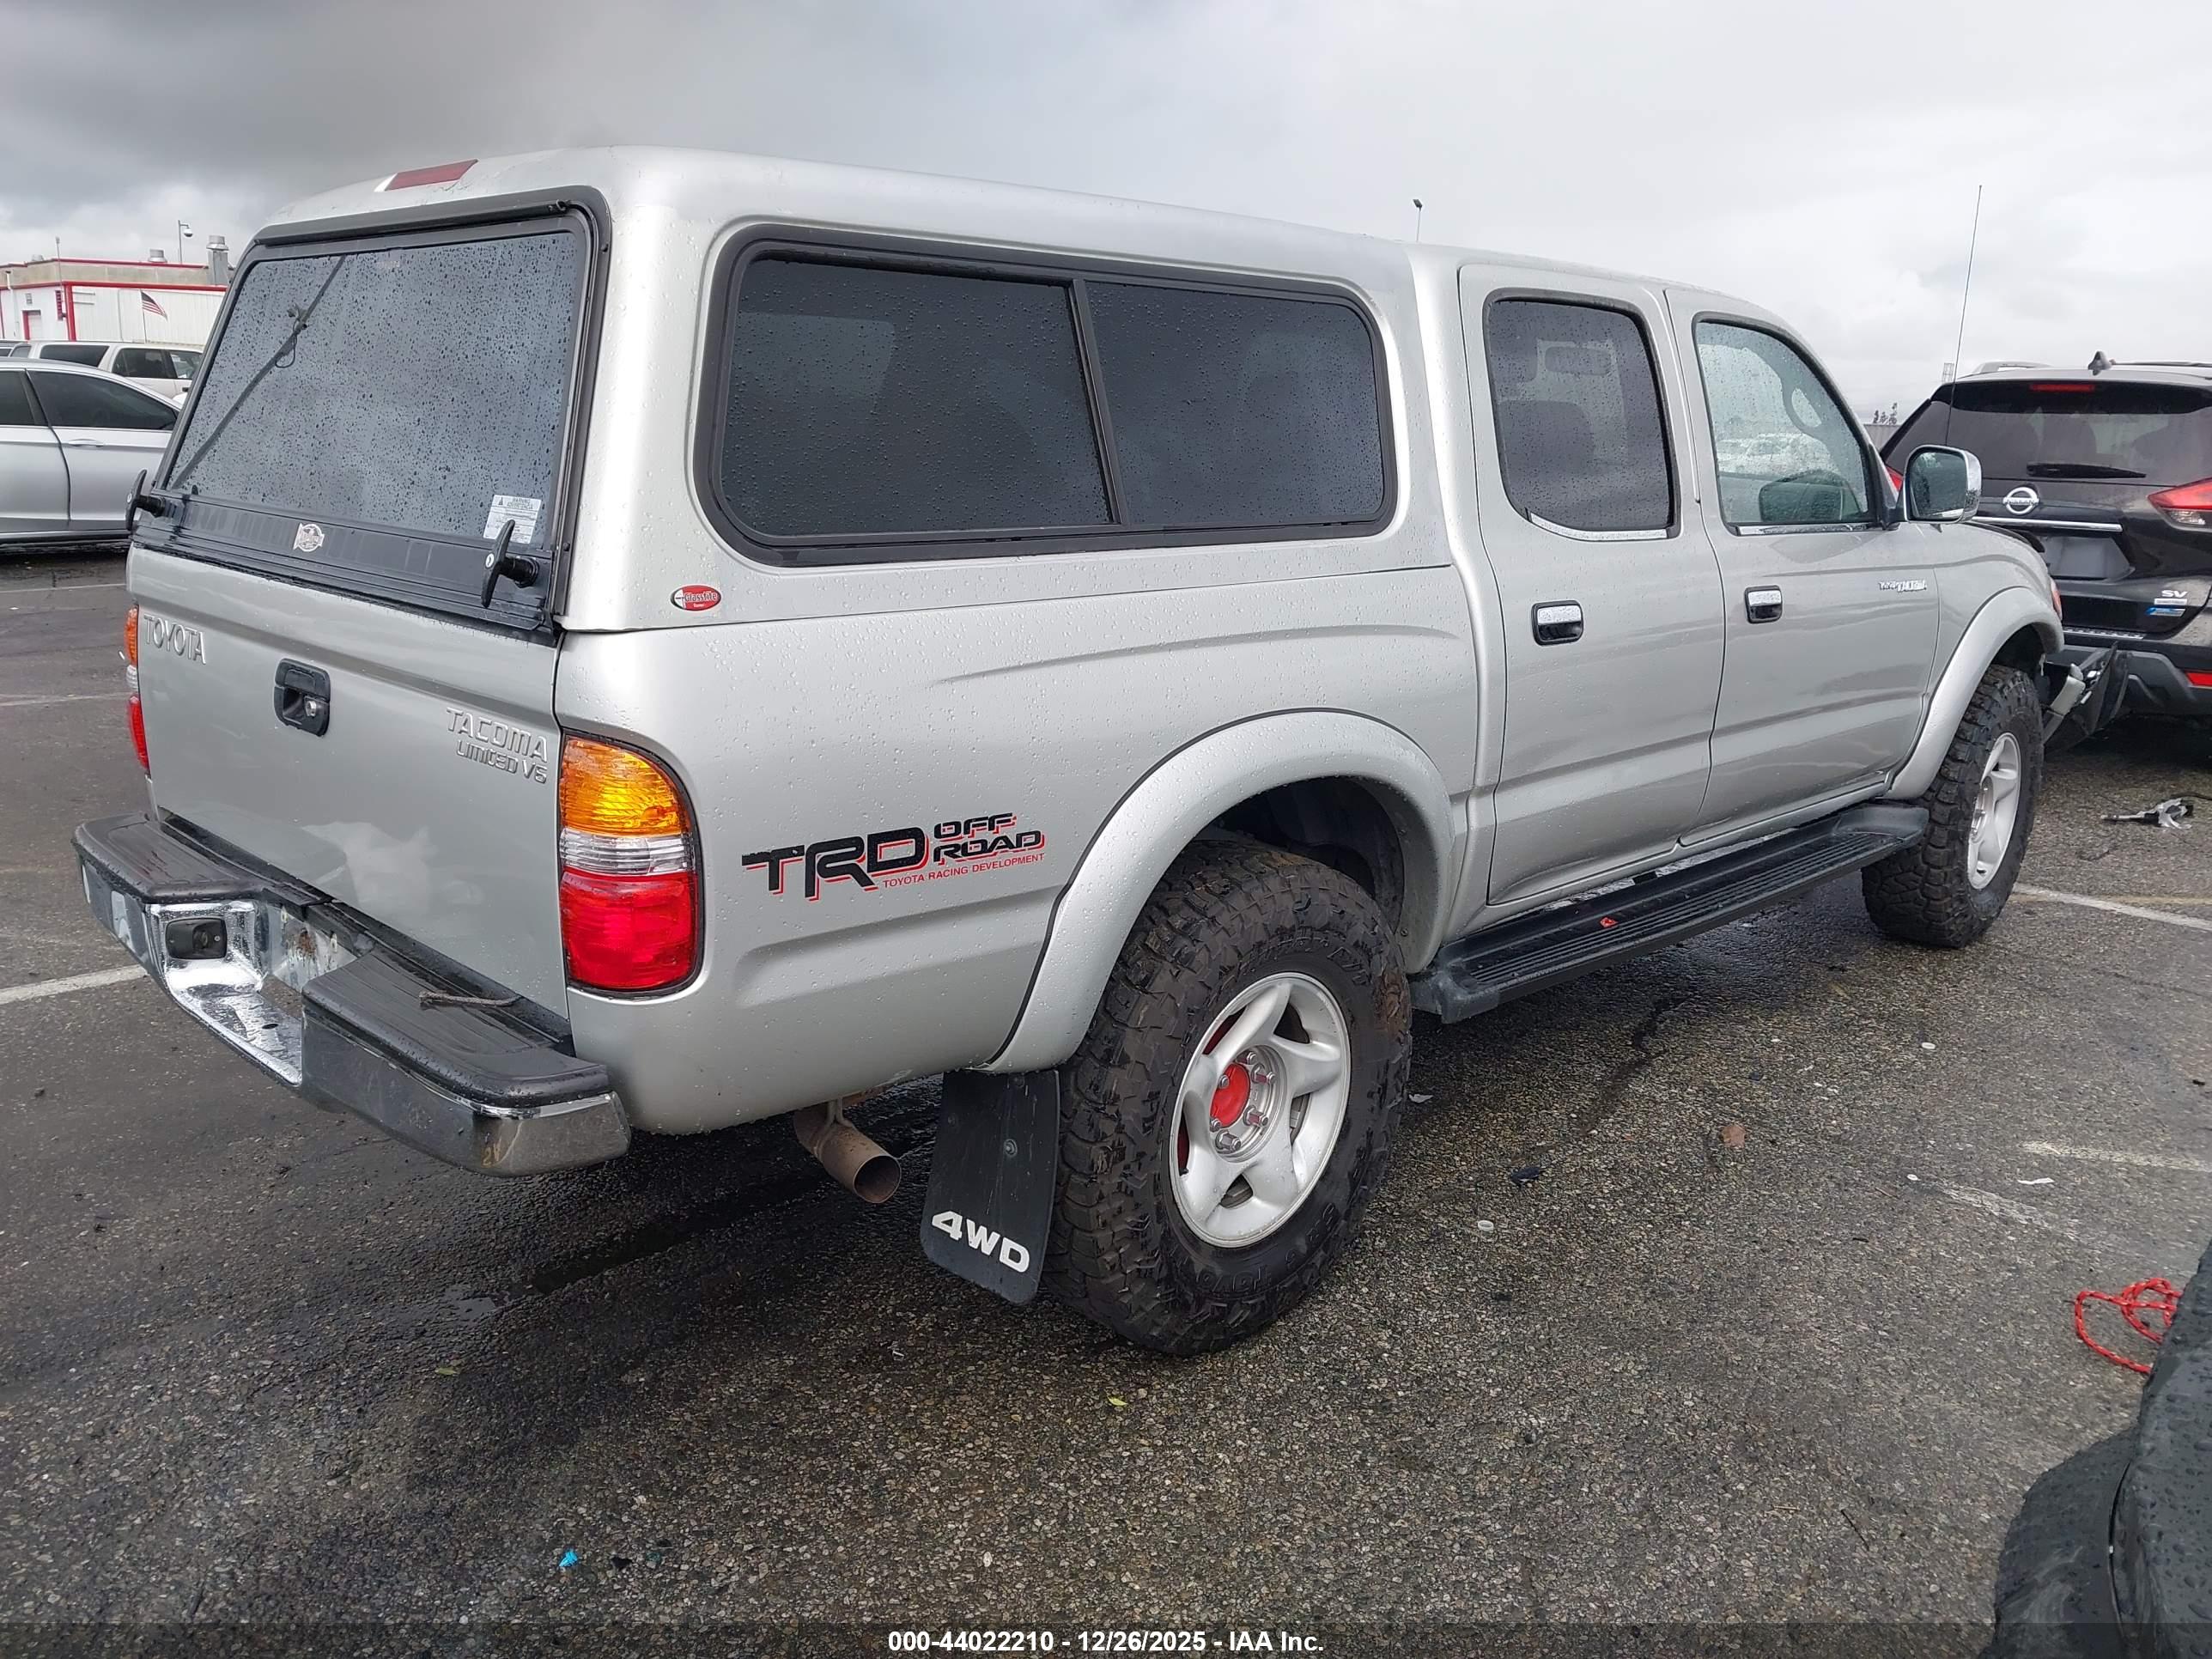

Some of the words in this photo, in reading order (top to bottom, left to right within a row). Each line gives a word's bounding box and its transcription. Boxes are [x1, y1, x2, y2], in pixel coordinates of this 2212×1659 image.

[2161, 589, 2188, 599] SV
[143, 613, 207, 665] TOYOTA
[446, 707, 548, 763] TACOMA
[522, 759, 548, 785] V6
[933, 812, 1017, 842] OFF
[741, 826, 929, 901] TRD
[933, 830, 1045, 866] ROAD
[883, 873, 925, 889] TOYOTA
[928, 863, 969, 881] RACING
[972, 853, 1045, 873] DEVELOPMENT
[931, 1210, 1030, 1273] 4WD
